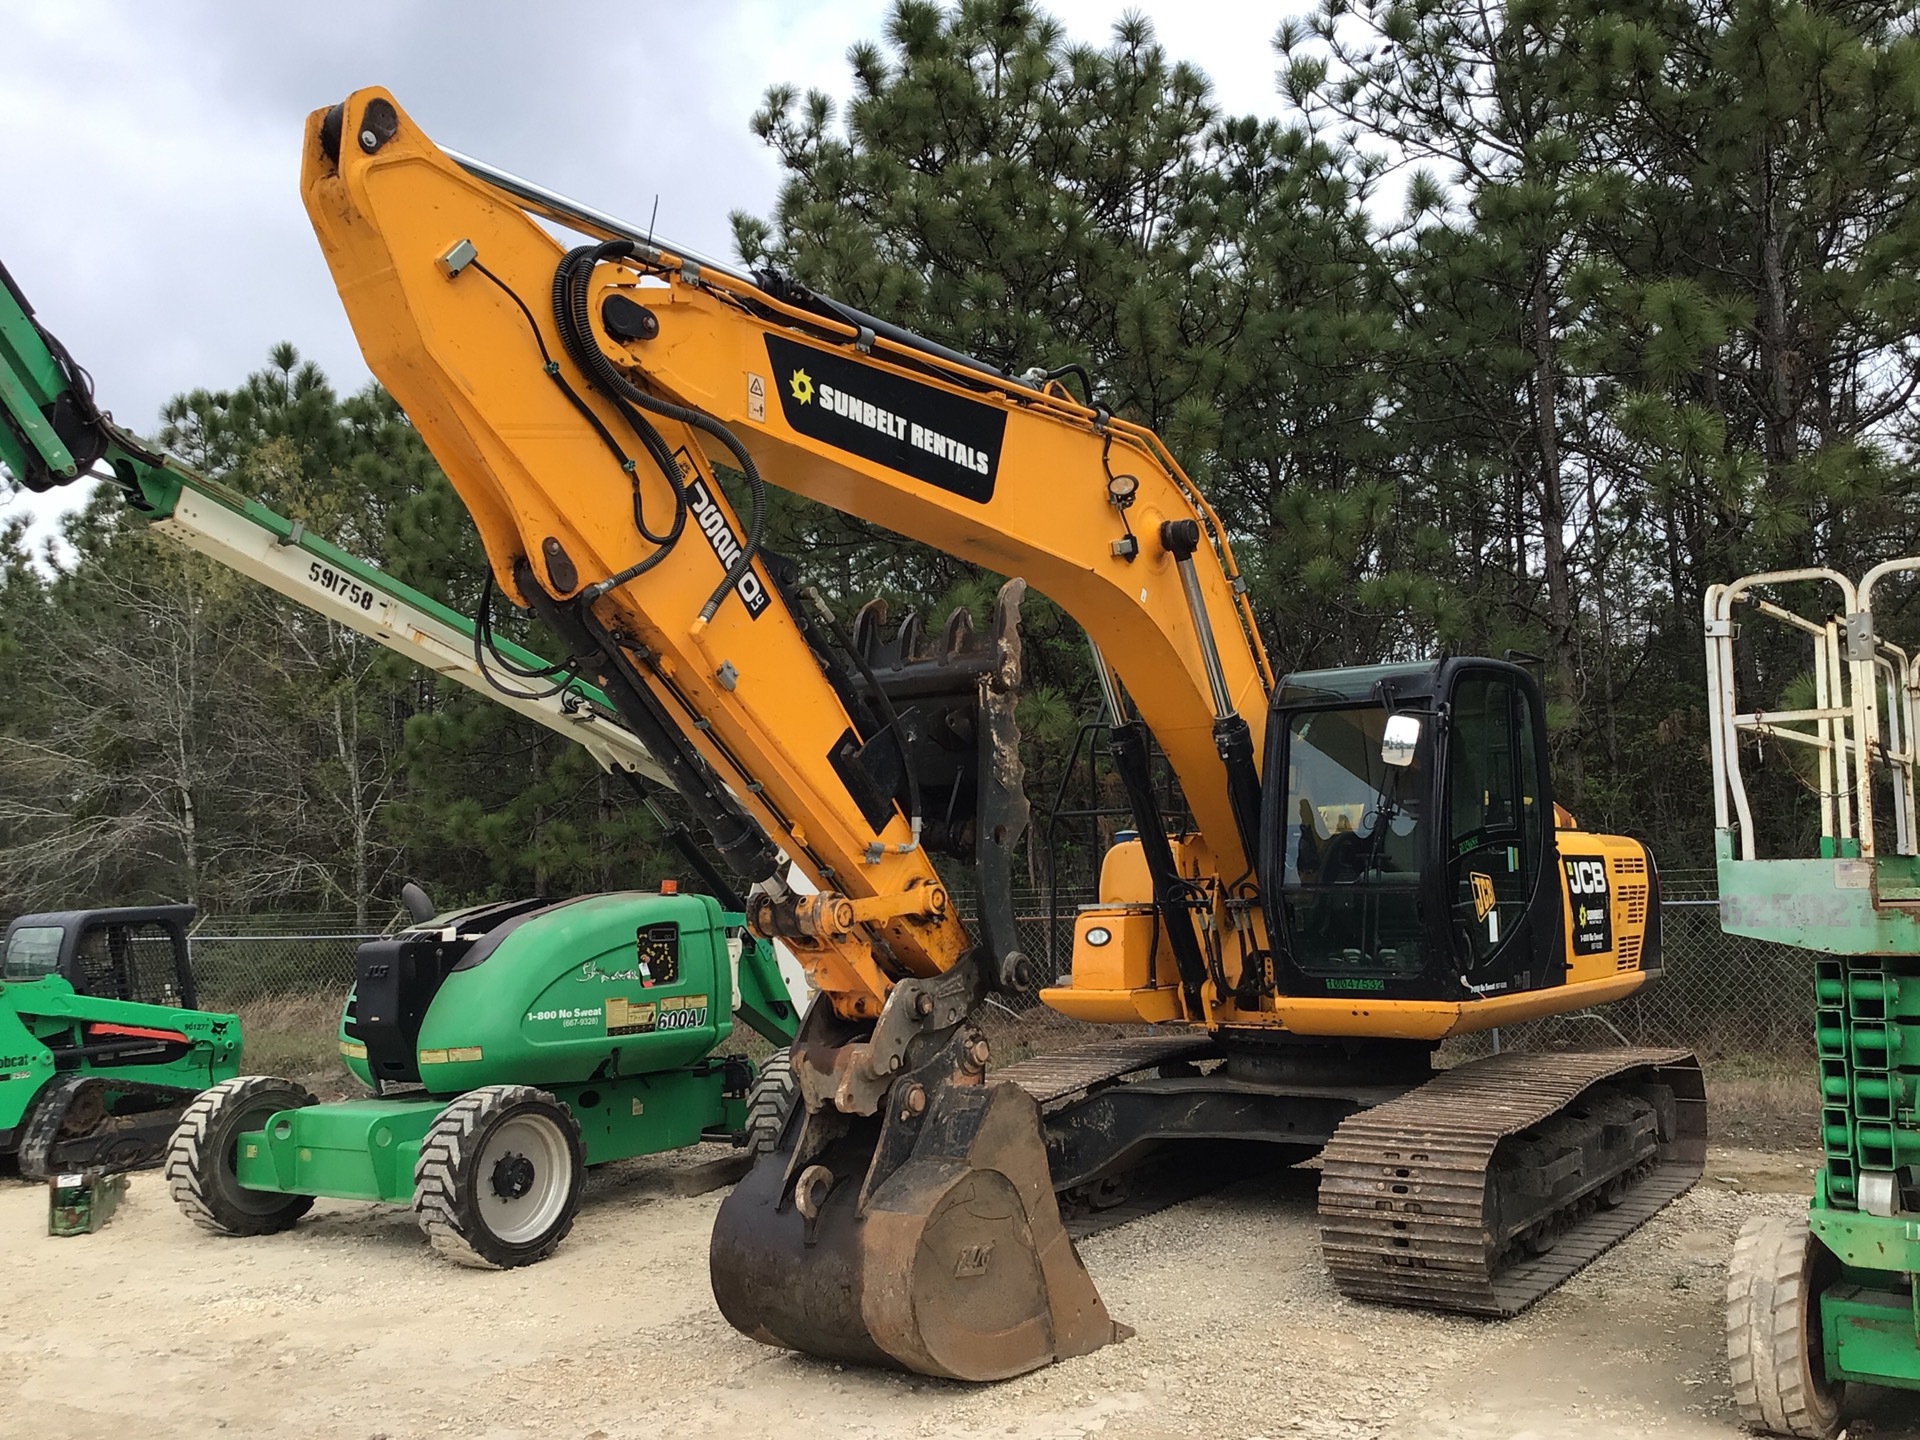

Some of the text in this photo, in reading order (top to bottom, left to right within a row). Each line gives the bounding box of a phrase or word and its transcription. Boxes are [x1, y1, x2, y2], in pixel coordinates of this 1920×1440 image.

[818, 383, 990, 476] SUNBELT RENTALS
[308, 561, 374, 611] 591758
[750, 593, 765, 612] LC
[1570, 861, 1607, 894] JCB
[1474, 876, 1494, 916] JCB
[527, 1007, 602, 1021] 1-800 No Sweat
[562, 1017, 599, 1028] (667-9328)
[656, 1008, 707, 1029] 600AJ
[0, 1054, 28, 1068] obcat
